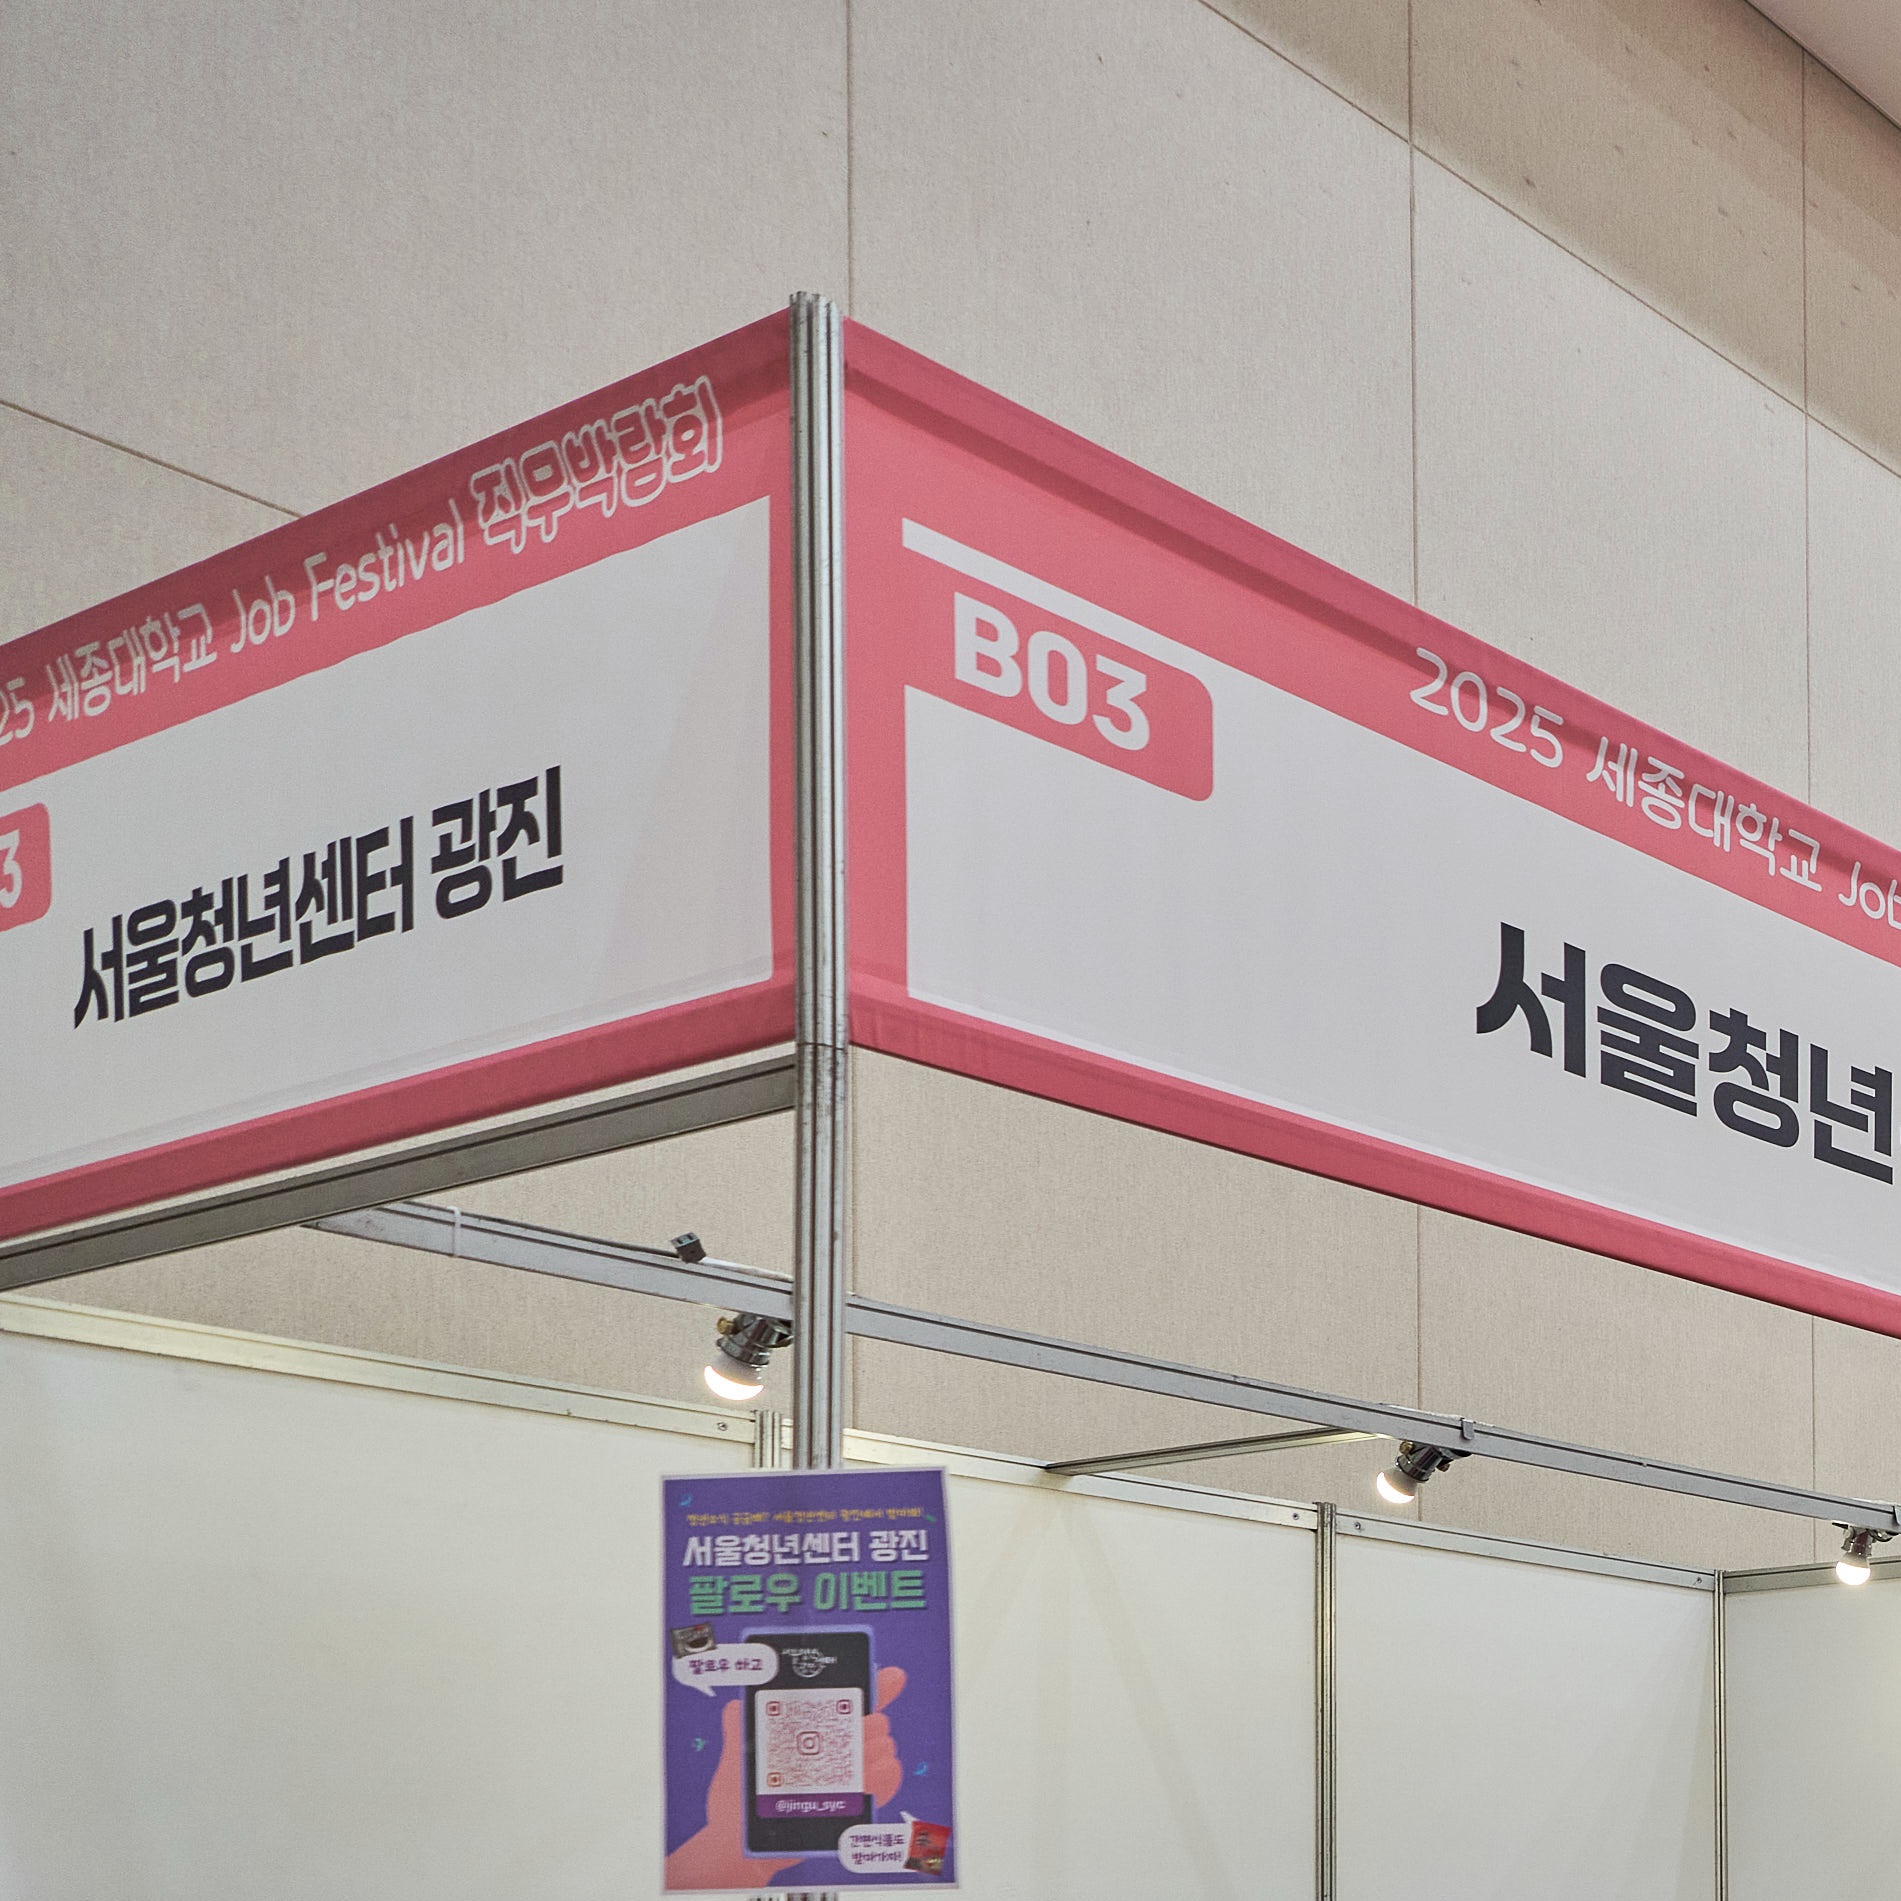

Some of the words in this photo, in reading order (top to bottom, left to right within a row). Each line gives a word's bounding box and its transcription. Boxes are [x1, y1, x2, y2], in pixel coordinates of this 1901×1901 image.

[48, 604, 216, 722] 세종대학교
[231, 577, 296, 656] Job
[308, 516, 465, 623] Festival
[472, 375, 725, 554] 직무박람회
[954, 591, 1150, 750] B03
[1409, 646, 1564, 769] 2025
[1586, 733, 1822, 893] 세종대학교
[74, 817, 413, 1029] 서울청년센터
[430, 764, 564, 919] 광진
[682, 1531, 860, 1567] 서울청년센터
[868, 1529, 929, 1562] 광진
[688, 1573, 801, 1615] 팔로우
[814, 1570, 926, 1611] 이벤트
[689, 1658, 730, 1675] 팔로우
[735, 1657, 763, 1672] 하고
